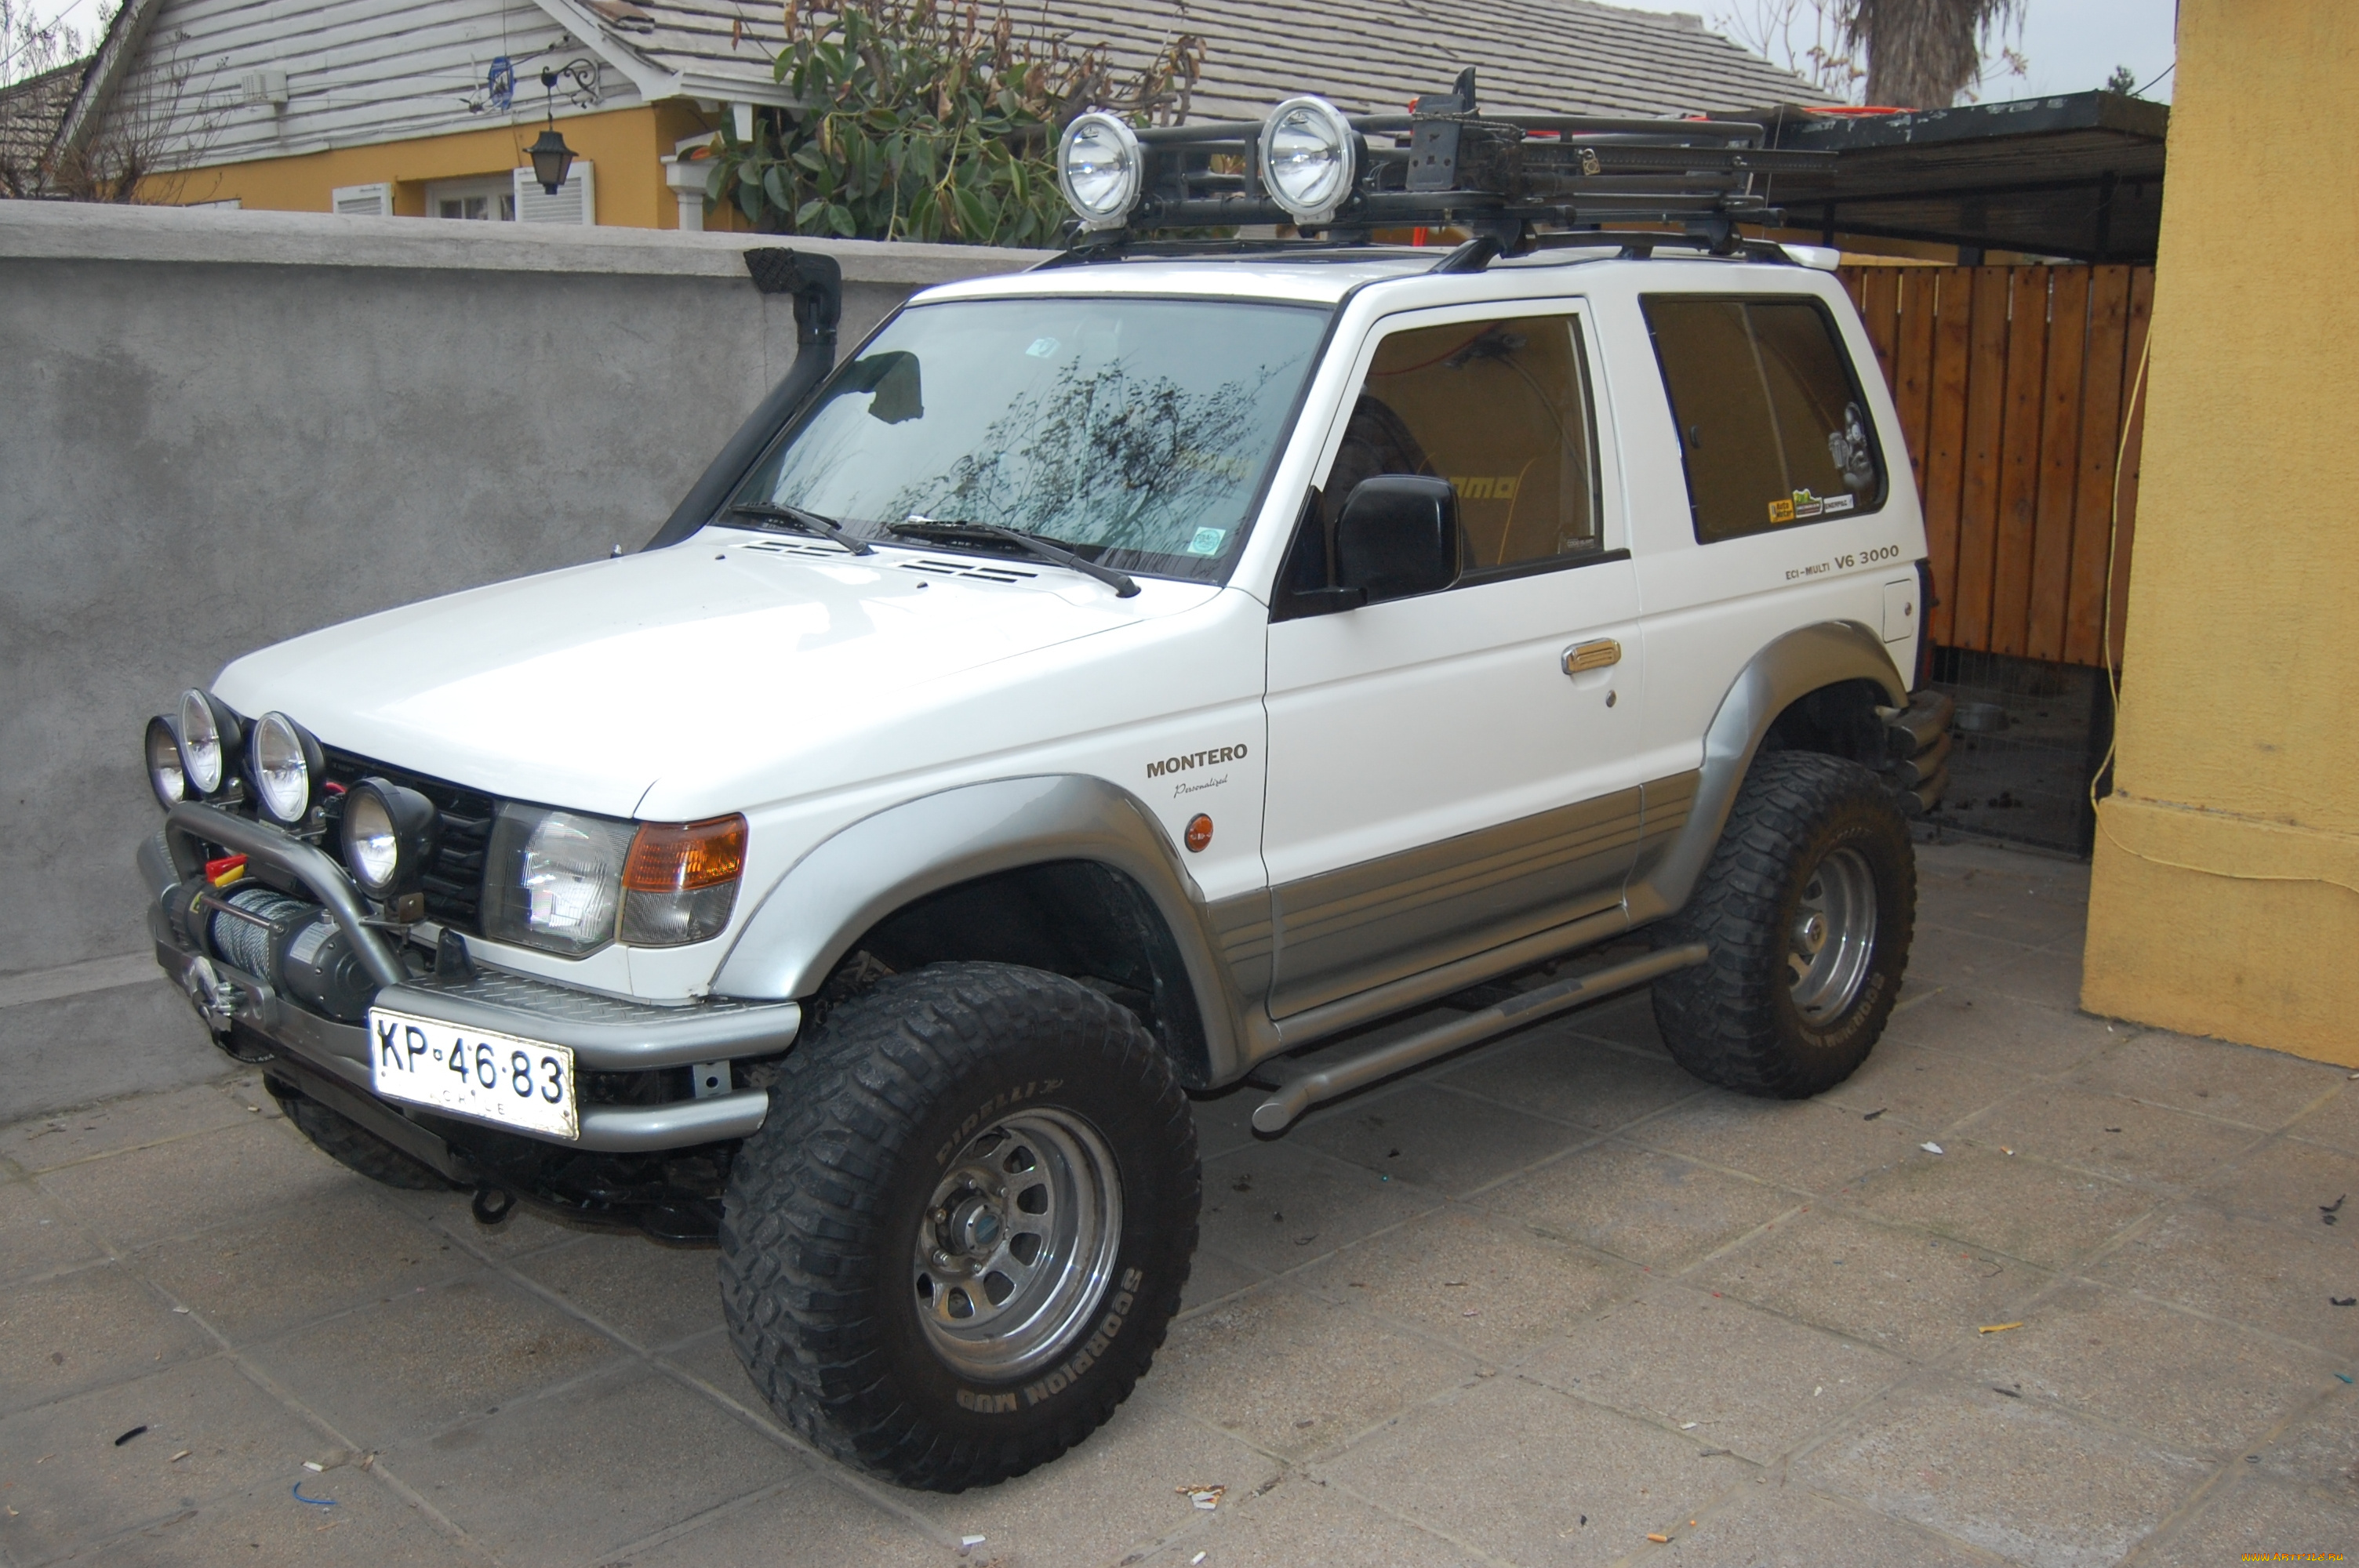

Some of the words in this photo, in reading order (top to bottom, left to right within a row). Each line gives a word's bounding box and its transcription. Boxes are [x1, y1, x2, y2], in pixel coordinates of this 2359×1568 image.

[1786, 562, 1830, 580] ECI-MULTI
[1834, 554, 1854, 569] V6
[1859, 545, 1899, 564] 3000
[1147, 743, 1248, 779] MONTERO
[1173, 773, 1228, 799] Personalized
[936, 1081, 1037, 1166] PIRELLI
[1023, 1267, 1143, 1406] SCORPION
[956, 1388, 1018, 1414] MUD
